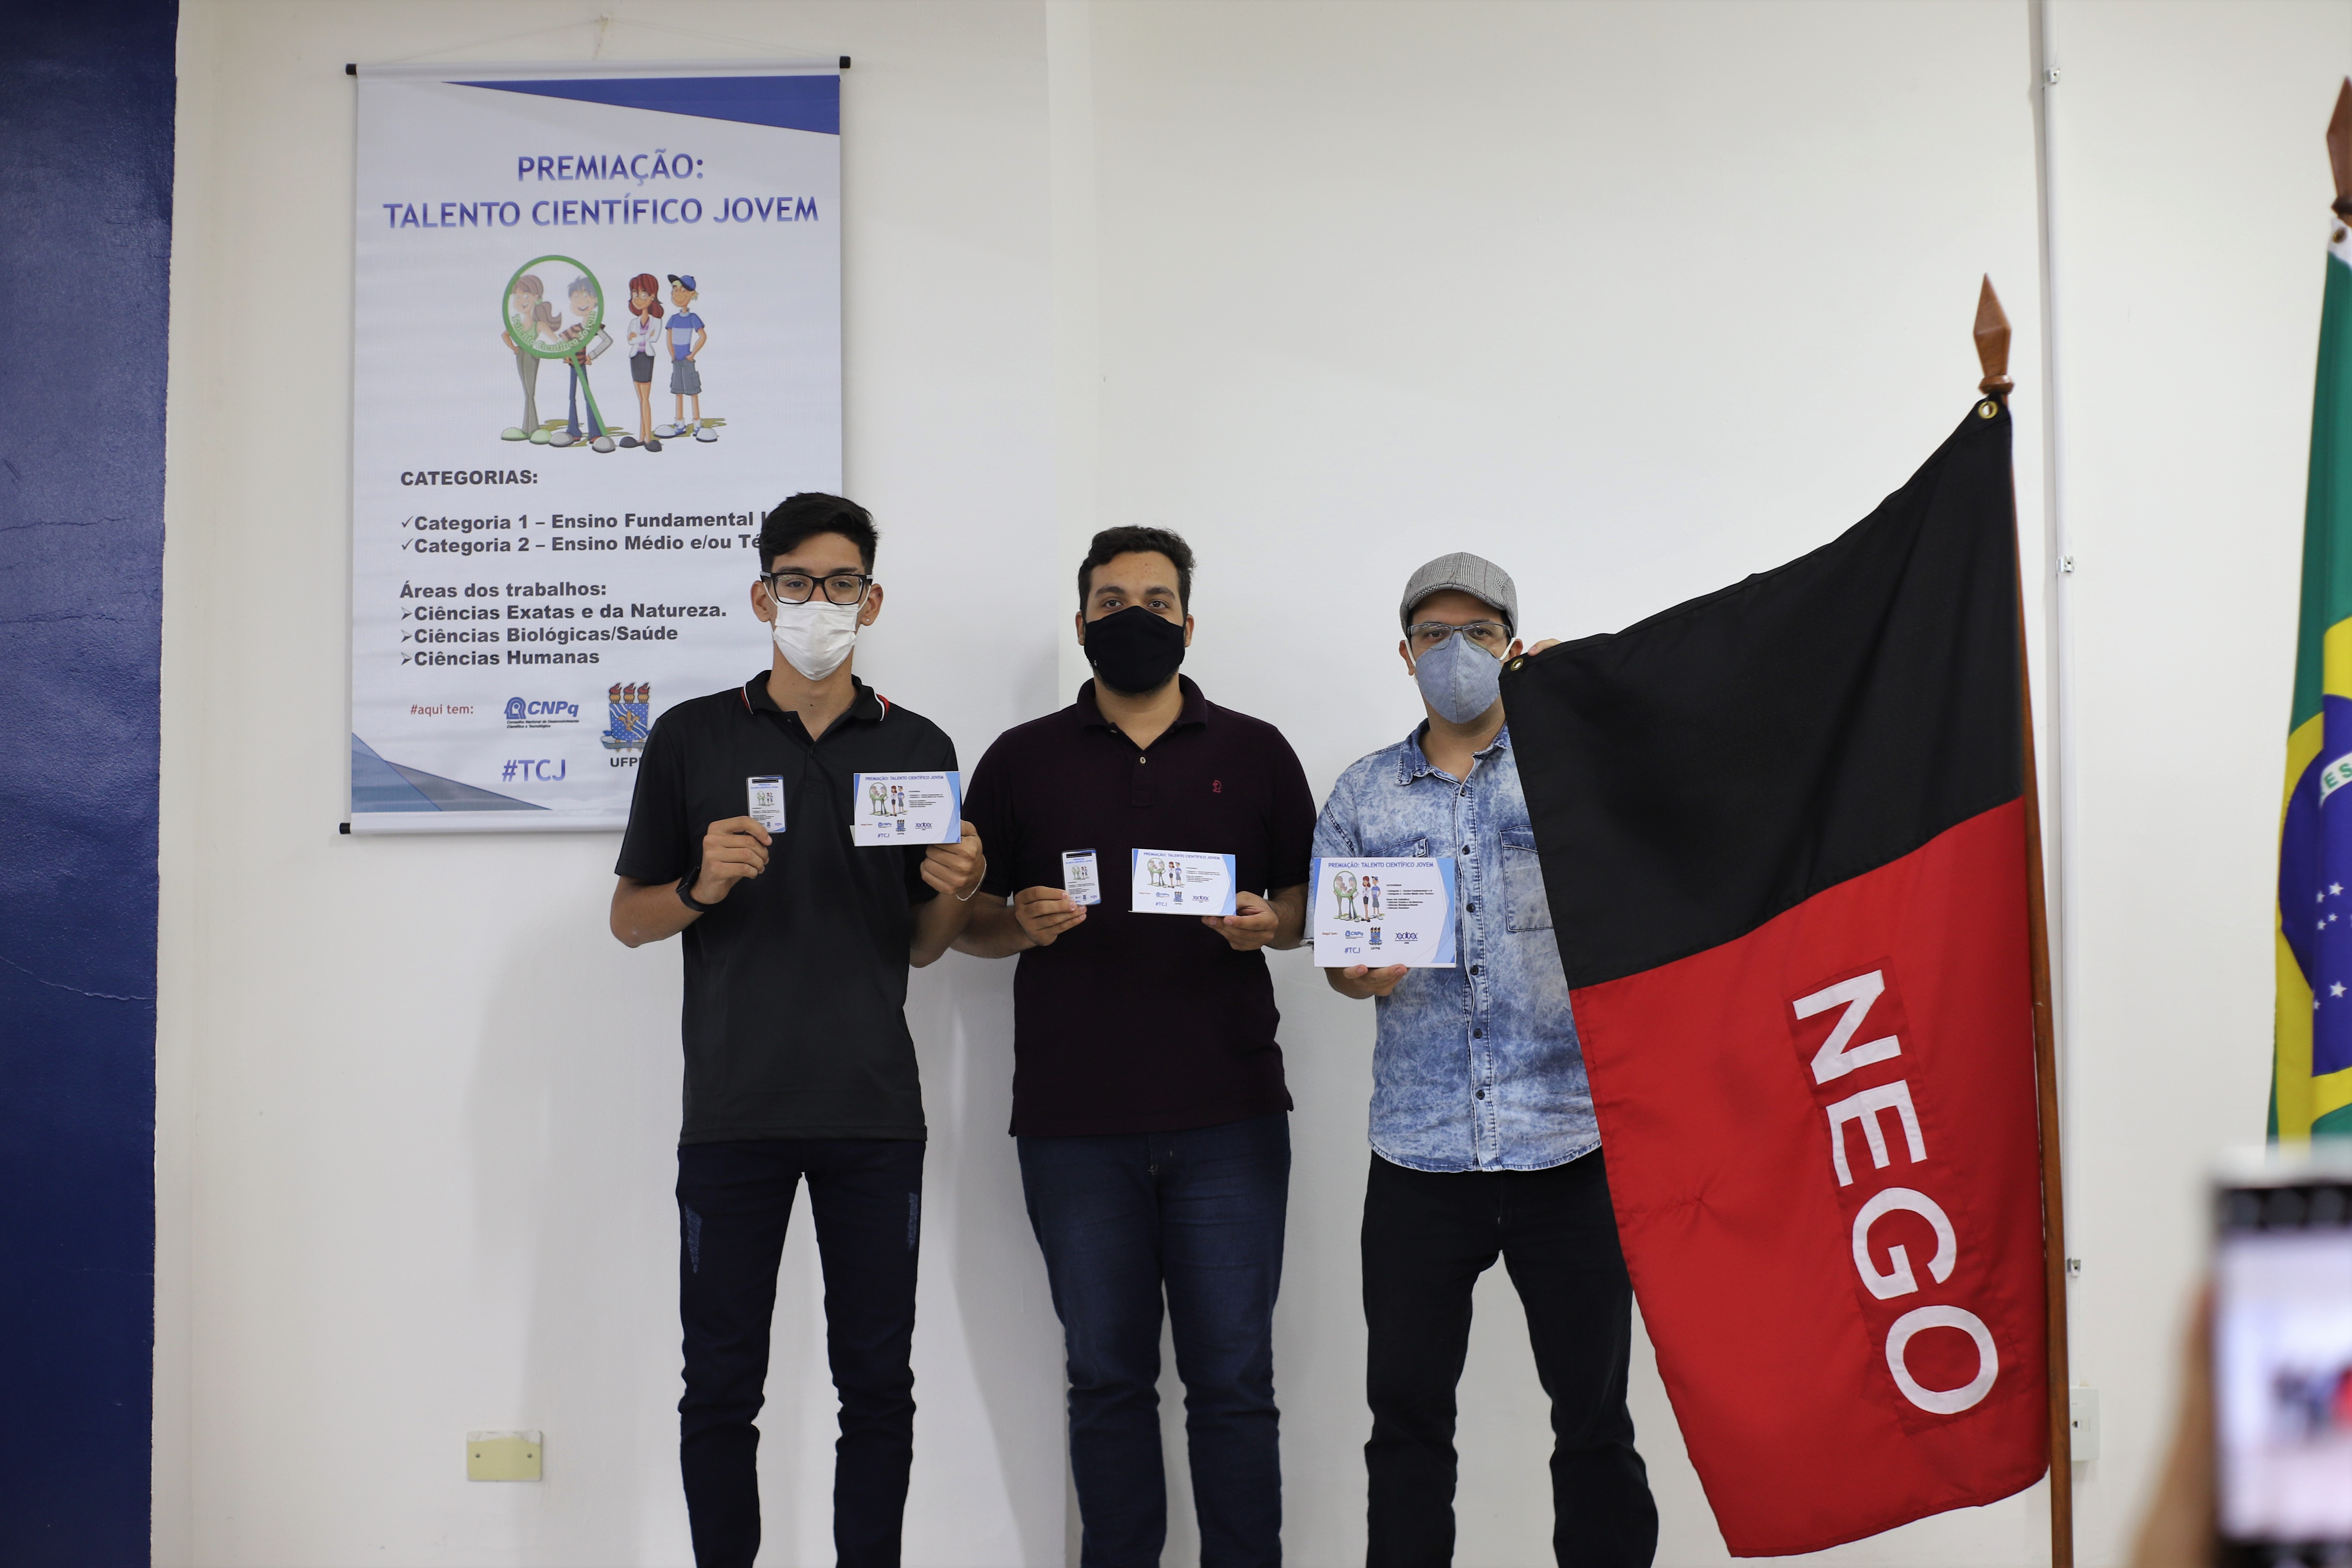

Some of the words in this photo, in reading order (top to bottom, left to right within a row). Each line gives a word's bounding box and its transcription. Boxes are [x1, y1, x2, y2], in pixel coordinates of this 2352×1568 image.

[518, 149, 704, 185] PREMIAÇÃO:
[383, 202, 520, 228] TALENTO
[532, 193, 702, 225] CIENTÍFICO
[714, 196, 818, 222] JOVEM
[401, 470, 537, 486] CATEGORIAS:
[415, 515, 510, 533] Categoria
[519, 515, 528, 529] 1
[552, 514, 617, 528] Ensino
[625, 511, 753, 527] Fundamental
[415, 537, 510, 556] Categoria
[518, 537, 529, 551] 2
[552, 536, 617, 551] Ensino
[625, 534, 684, 550] Médio
[691, 534, 731, 549] e/ou
[738, 534, 760, 548] Té
[400, 580, 457, 598] Áreas
[464, 583, 499, 597] dos
[506, 582, 606, 597] trabalhos:
[415, 605, 500, 620] Ciências
[507, 605, 574, 619] Exatas
[582, 608, 593, 618] e
[600, 604, 623, 618] da
[631, 603, 727, 618] Natureza.
[415, 628, 500, 643] Ciências
[507, 625, 678, 645] Biológicas/Saúde
[415, 651, 500, 666] Ciências
[507, 650, 599, 665] Humanas
[410, 704, 443, 717] #aqui
[447, 704, 474, 714] tem:
[527, 701, 579, 717] CNPq
[502, 759, 566, 782] #TCJ
[610, 757, 642, 767] UFP
[2320, 763, 2352, 796] ES
[1793, 969, 1998, 1415] NEGO
